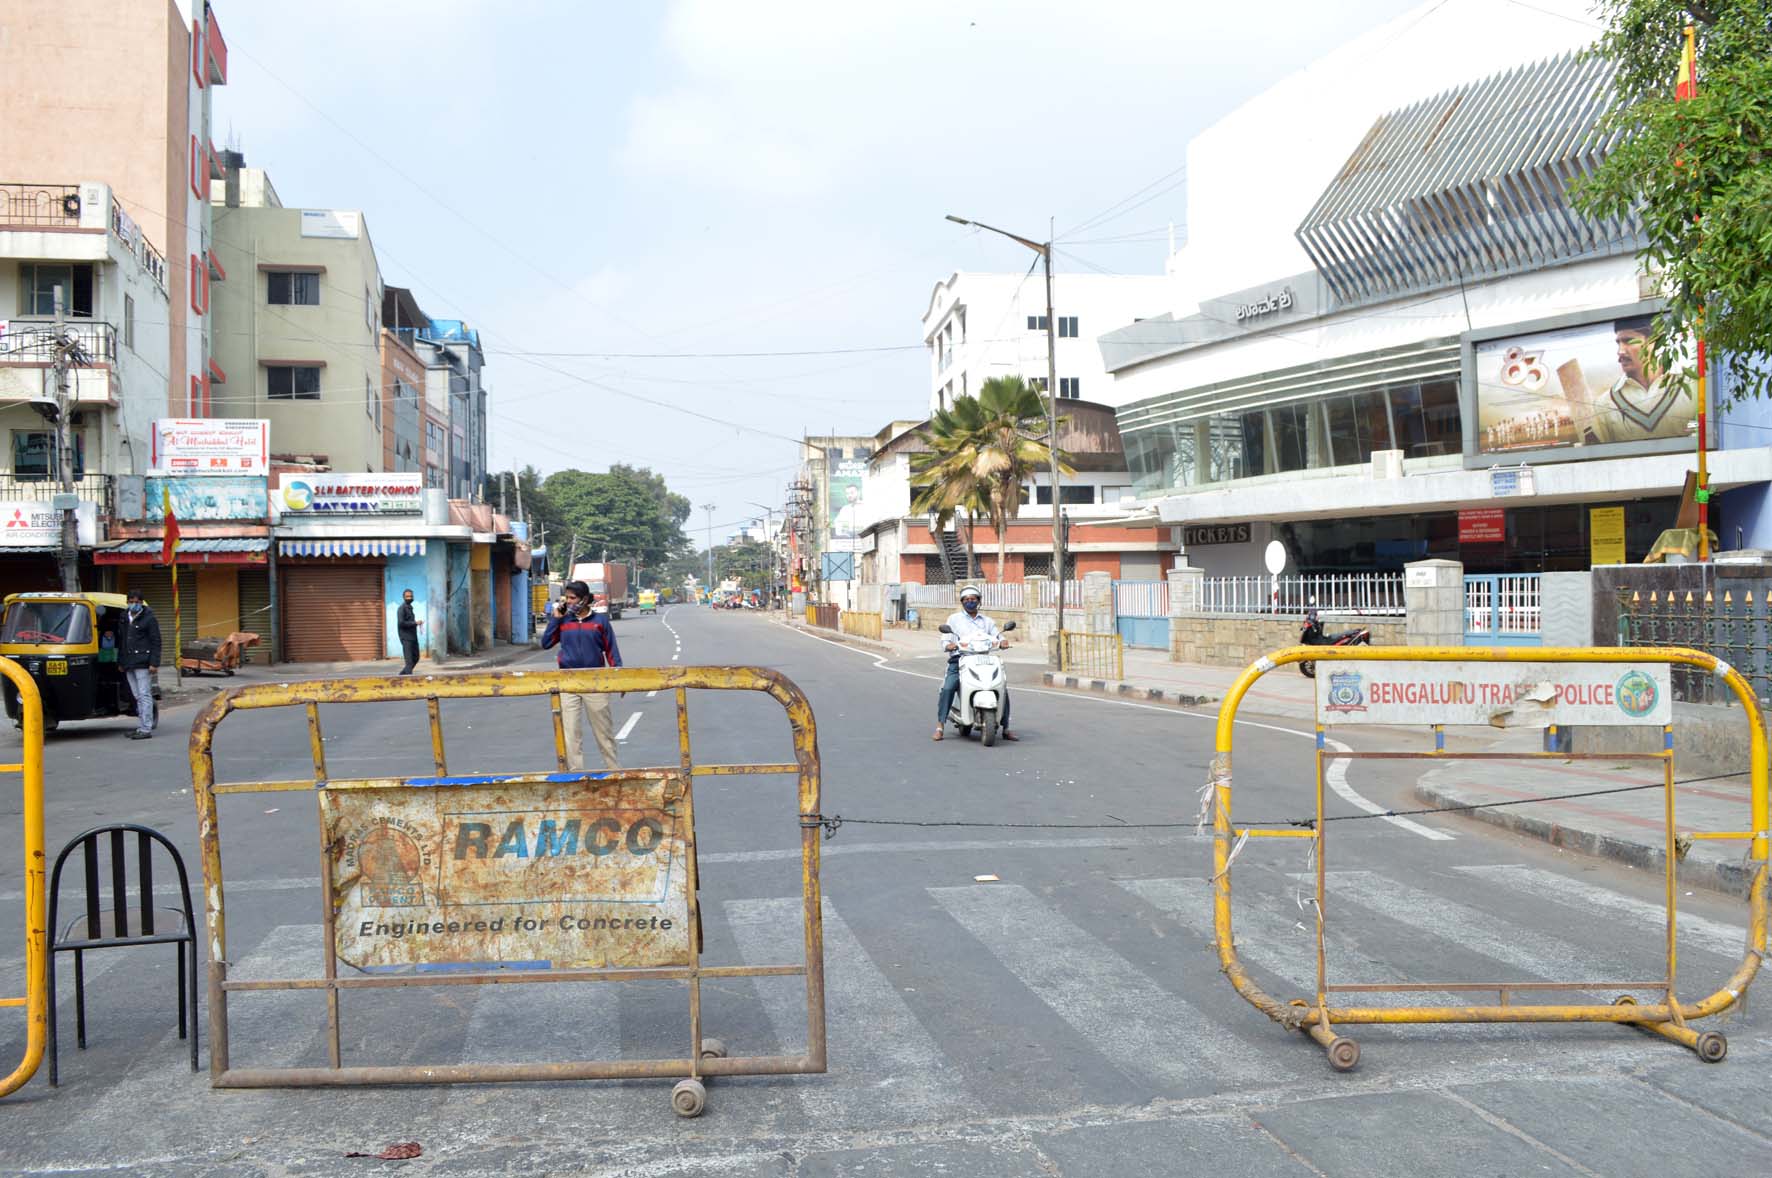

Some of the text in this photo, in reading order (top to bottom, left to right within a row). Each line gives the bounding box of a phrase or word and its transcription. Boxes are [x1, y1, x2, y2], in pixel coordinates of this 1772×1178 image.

[1501, 345, 1550, 390] 83
[335, 486, 380, 495] BATTERY
[381, 485, 421, 496] CONVOY
[31, 513, 63, 521] MITSUB
[1184, 526, 1248, 545] TICKETS
[1480, 682, 1537, 705] TRAF
[1554, 683, 1614, 705] POLICE
[371, 816, 424, 841] CEMENTS
[420, 843, 431, 865] LTD
[454, 817, 664, 861] RAMCO
[359, 914, 673, 938] Engineered for Concrete
